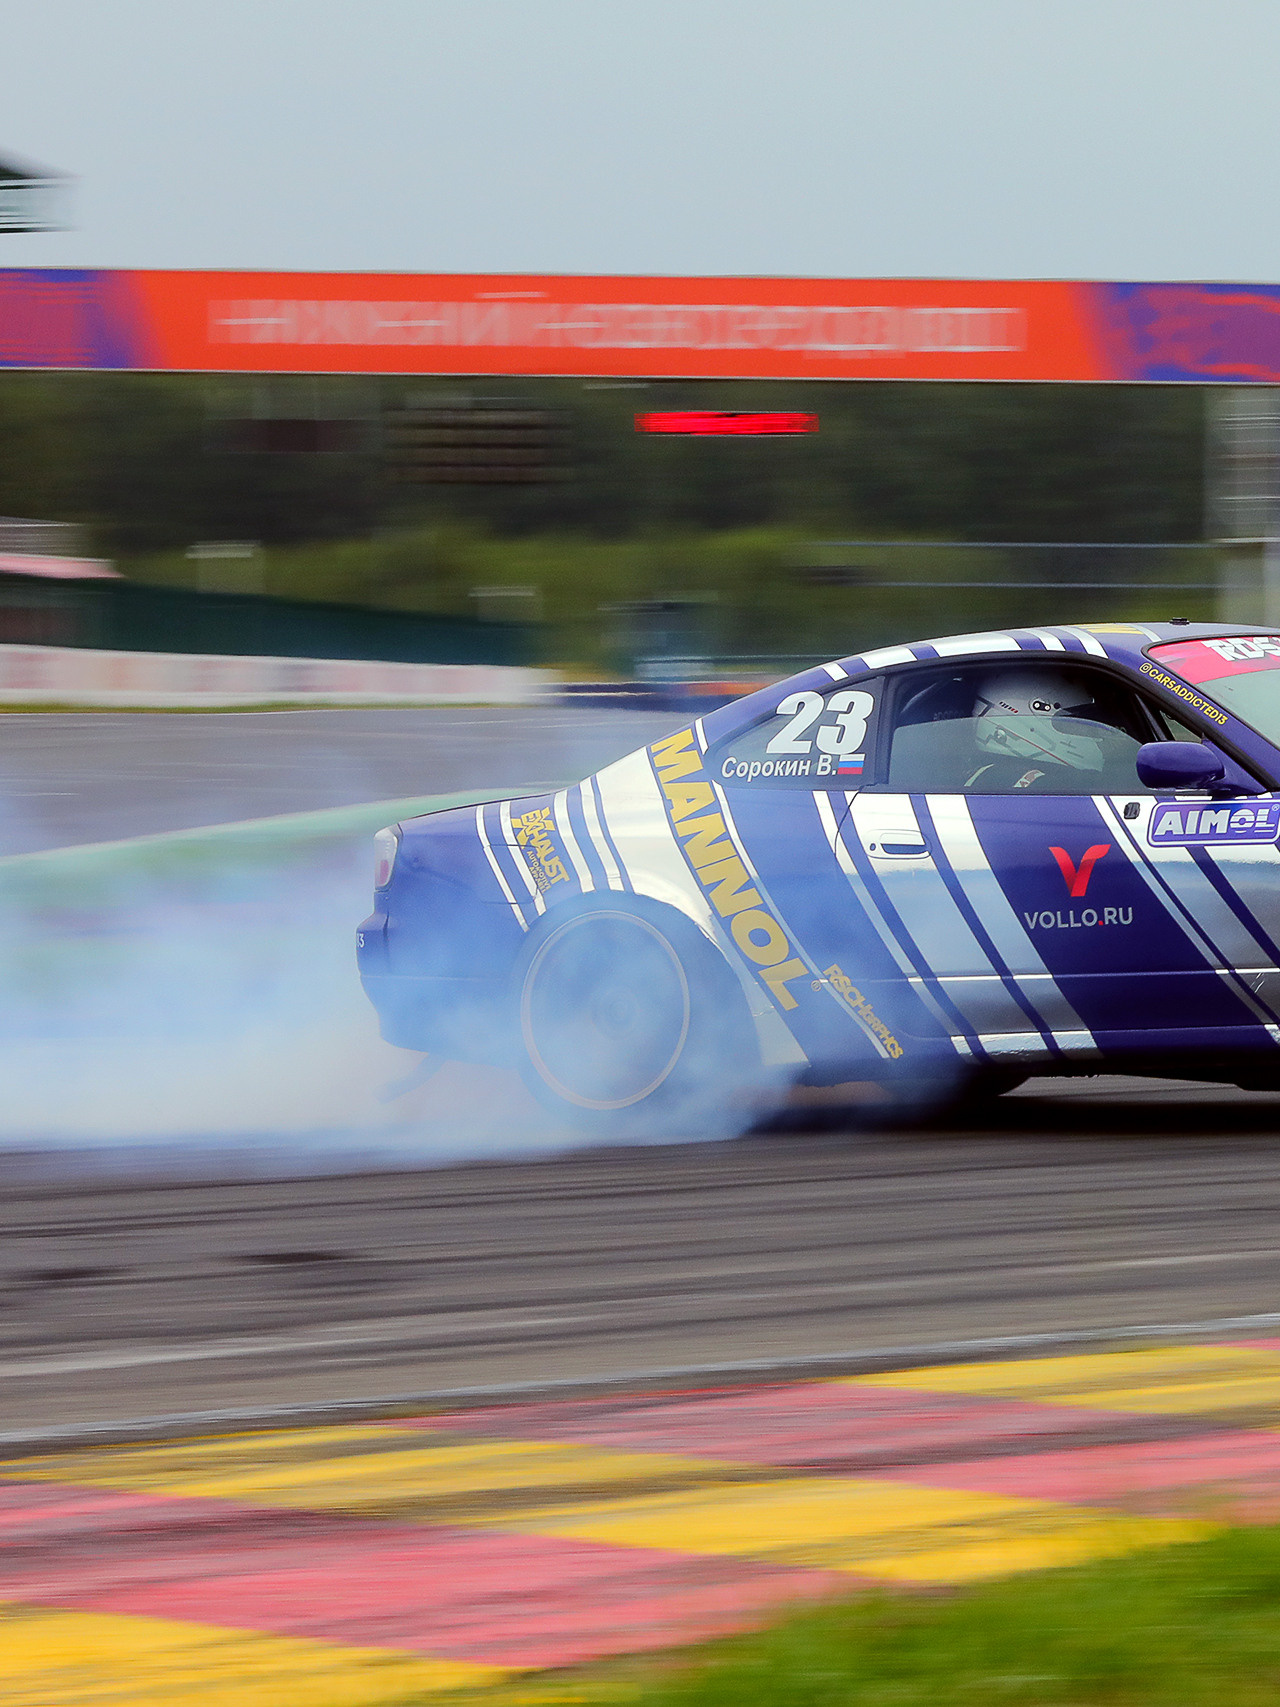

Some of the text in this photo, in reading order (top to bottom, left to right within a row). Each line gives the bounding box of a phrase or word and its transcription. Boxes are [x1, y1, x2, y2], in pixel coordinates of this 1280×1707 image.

[766, 690, 875, 755] 23
[721, 757, 811, 783] Сорокин
[1154, 808, 1276, 836] AIMOL
[511, 807, 570, 885] EXHAUST
[651, 728, 809, 1011] MANNOL
[1024, 906, 1133, 930] VOLLO.RU
